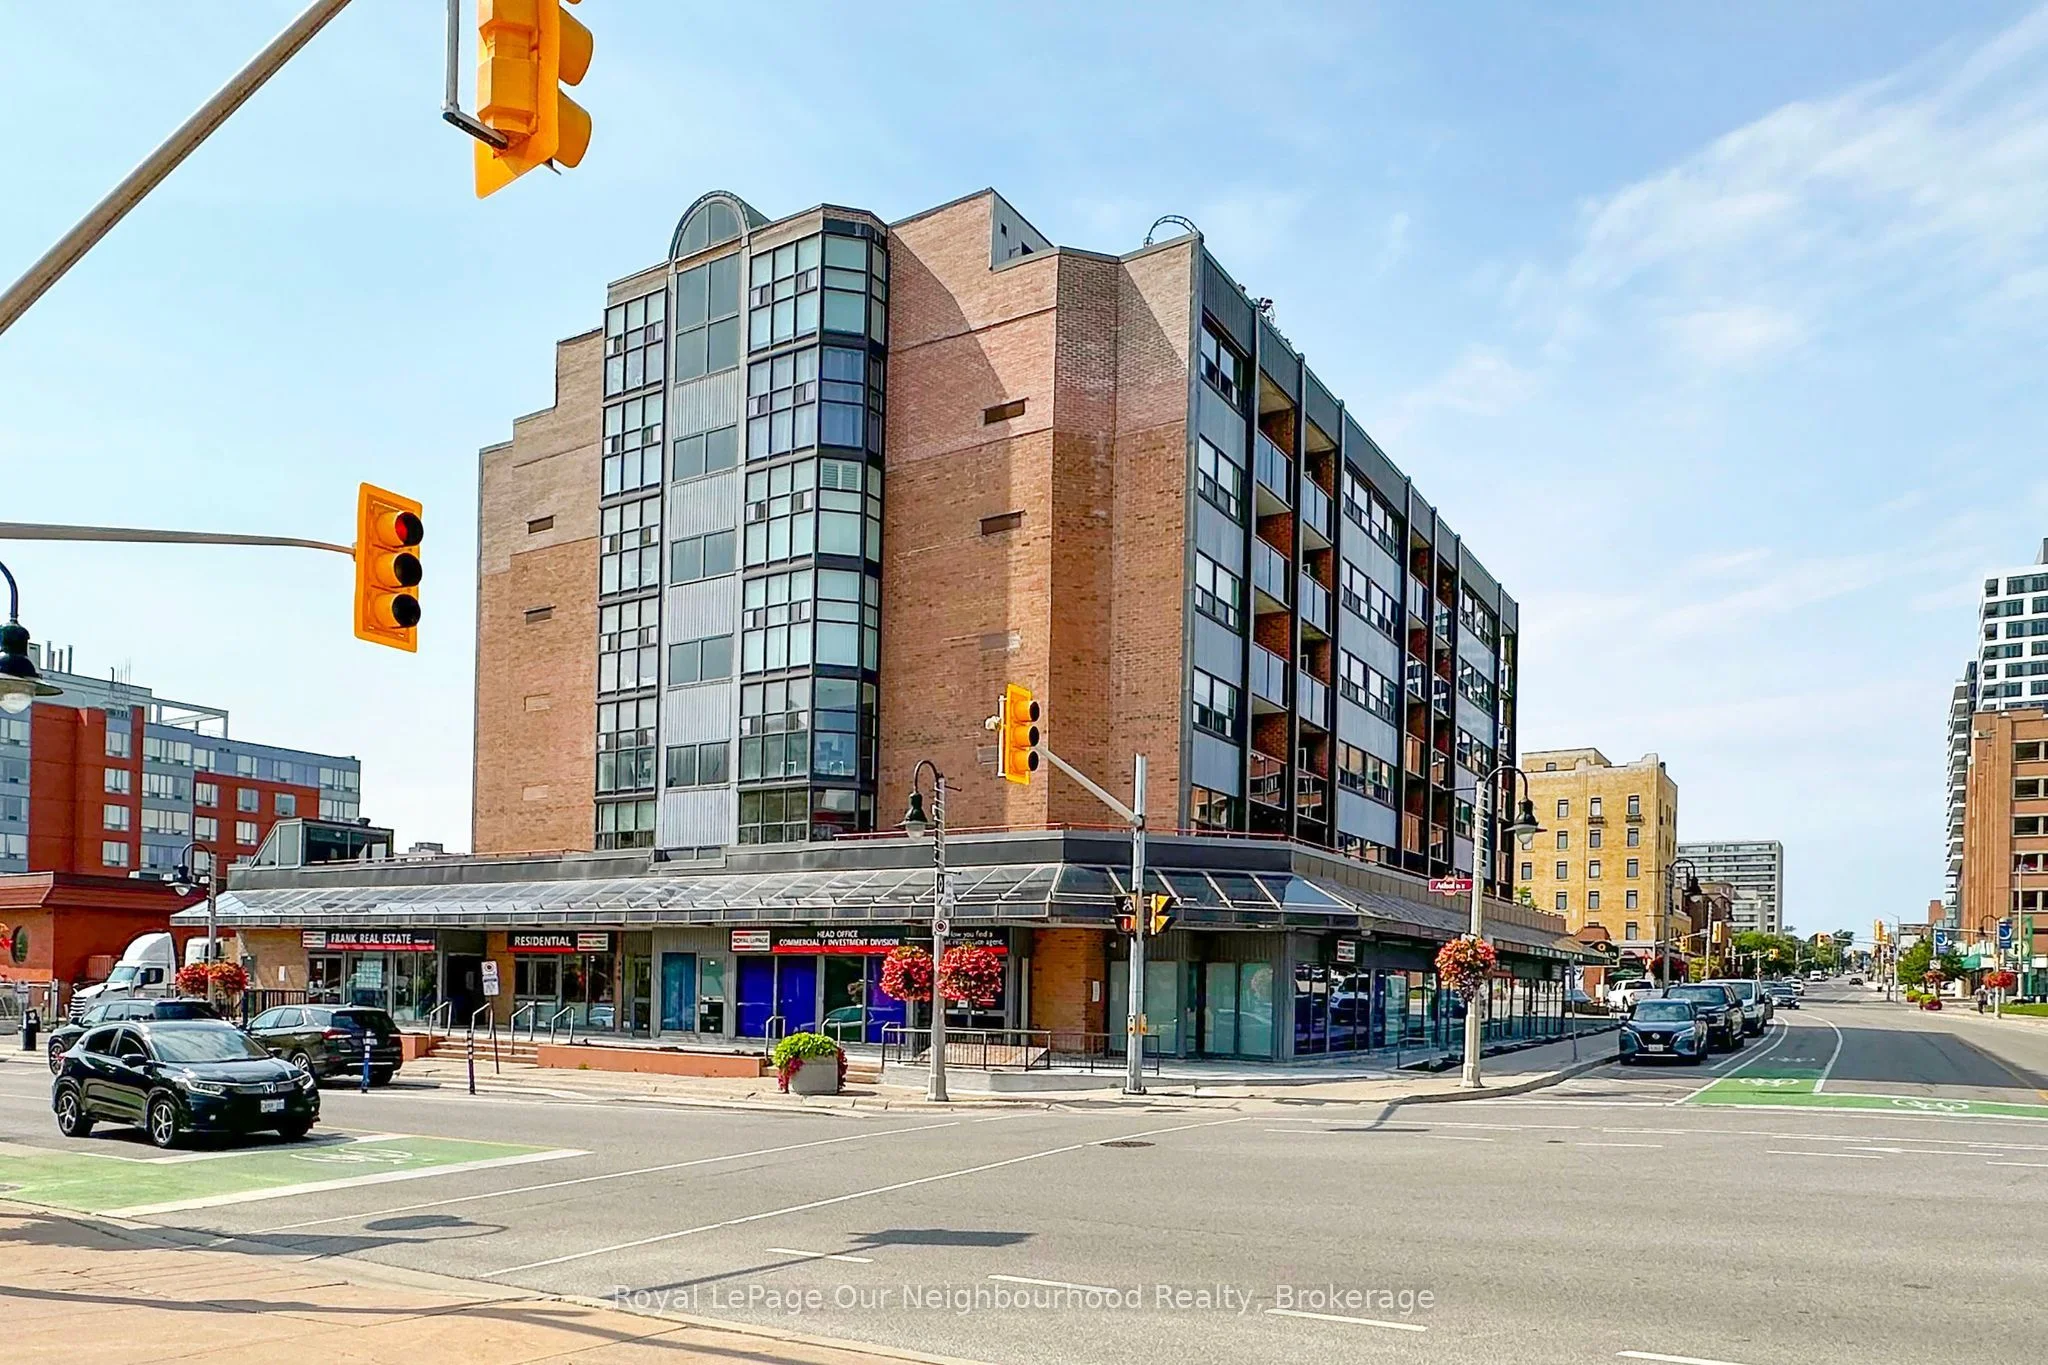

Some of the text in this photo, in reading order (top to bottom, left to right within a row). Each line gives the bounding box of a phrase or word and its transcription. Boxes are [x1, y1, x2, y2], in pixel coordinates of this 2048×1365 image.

[817, 930, 858, 938] HEAD OFFICE
[963, 931, 975, 939] you
[330, 933, 357, 944] FRANK
[359, 933, 380, 944] REAL
[382, 933, 412, 944] ESTATE
[514, 936, 571, 946] RESIDENTIAL
[779, 938, 820, 946] COMMERCIAL
[828, 938, 868, 946] INVESTMENT
[870, 938, 899, 946] DIVISION
